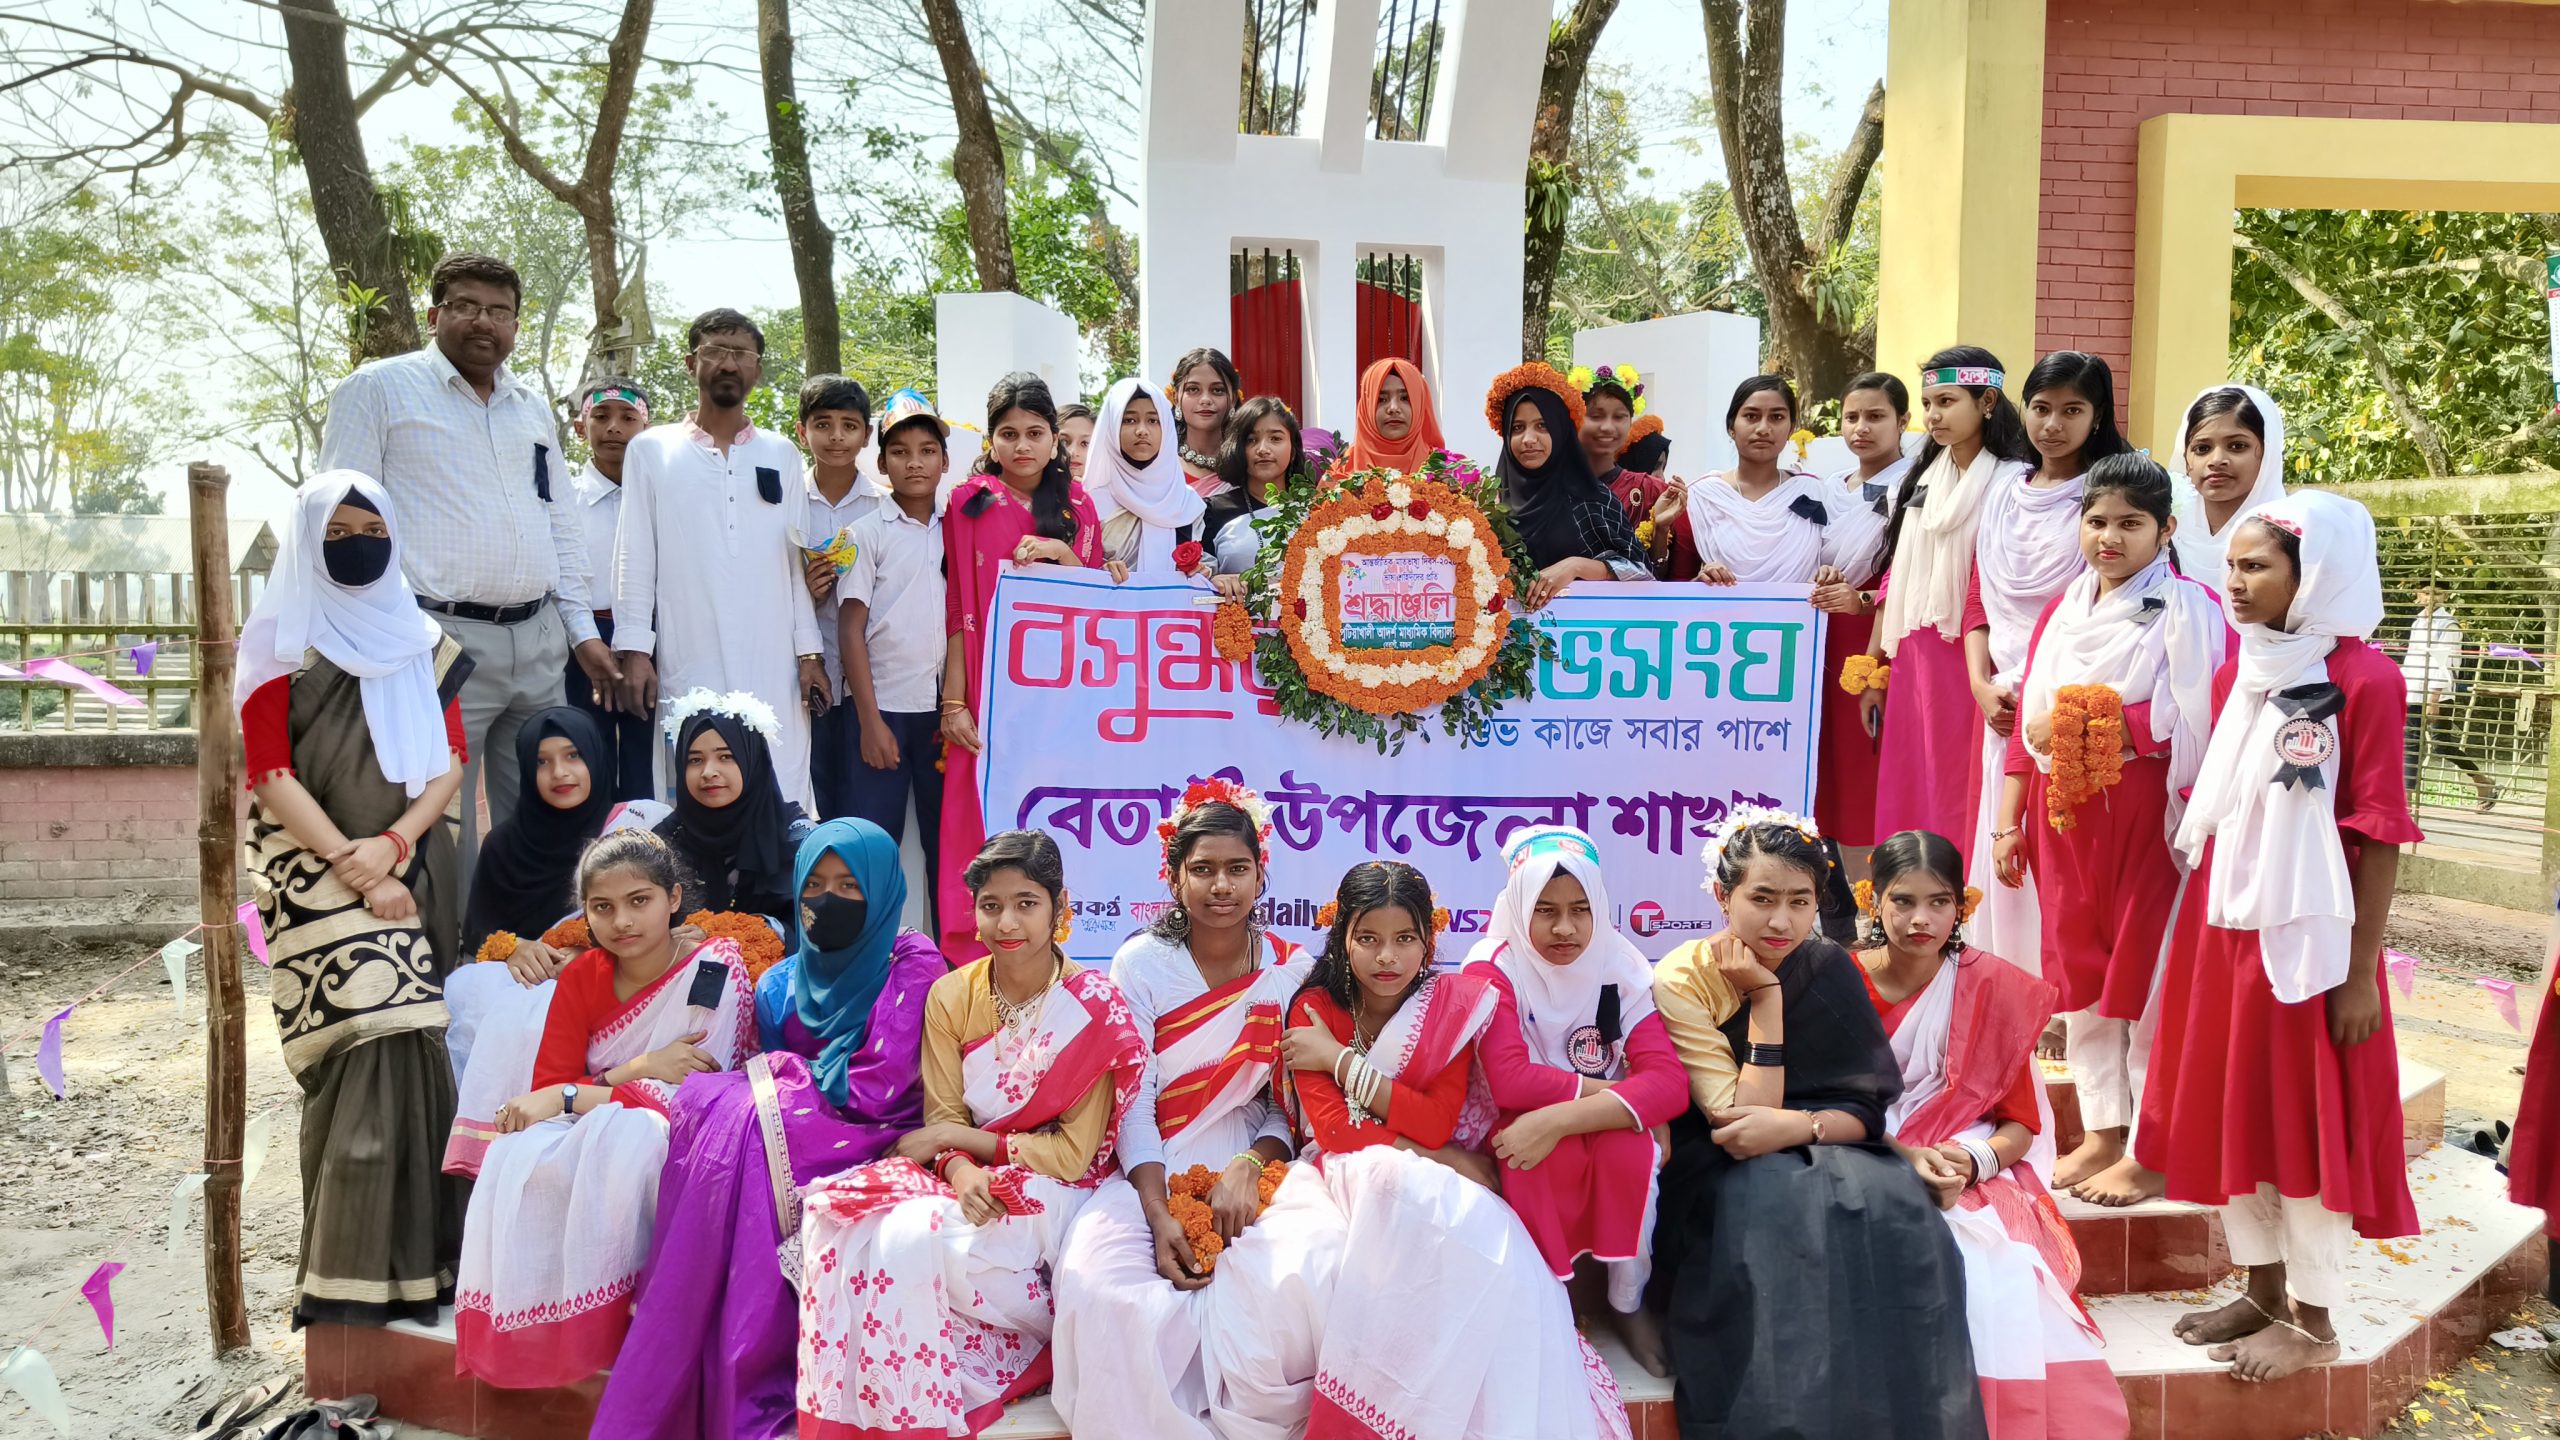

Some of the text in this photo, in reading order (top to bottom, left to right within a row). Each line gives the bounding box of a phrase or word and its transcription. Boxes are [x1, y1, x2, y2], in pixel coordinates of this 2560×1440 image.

[1344, 582, 1455, 620] শ্রদ্ধাঞ্জলি
[1376, 623, 1397, 640] আদর্শ
[1399, 623, 1428, 640] মাধ্যমিক
[1531, 715, 1613, 750] কাজে
[1626, 716, 1704, 752] সবার
[1717, 717, 1792, 752] পাশে
[1264, 770, 1599, 862] উপজেলা
[1086, 895, 1121, 916] কণ্ঠ
[1651, 921, 1711, 929] SPORTS
